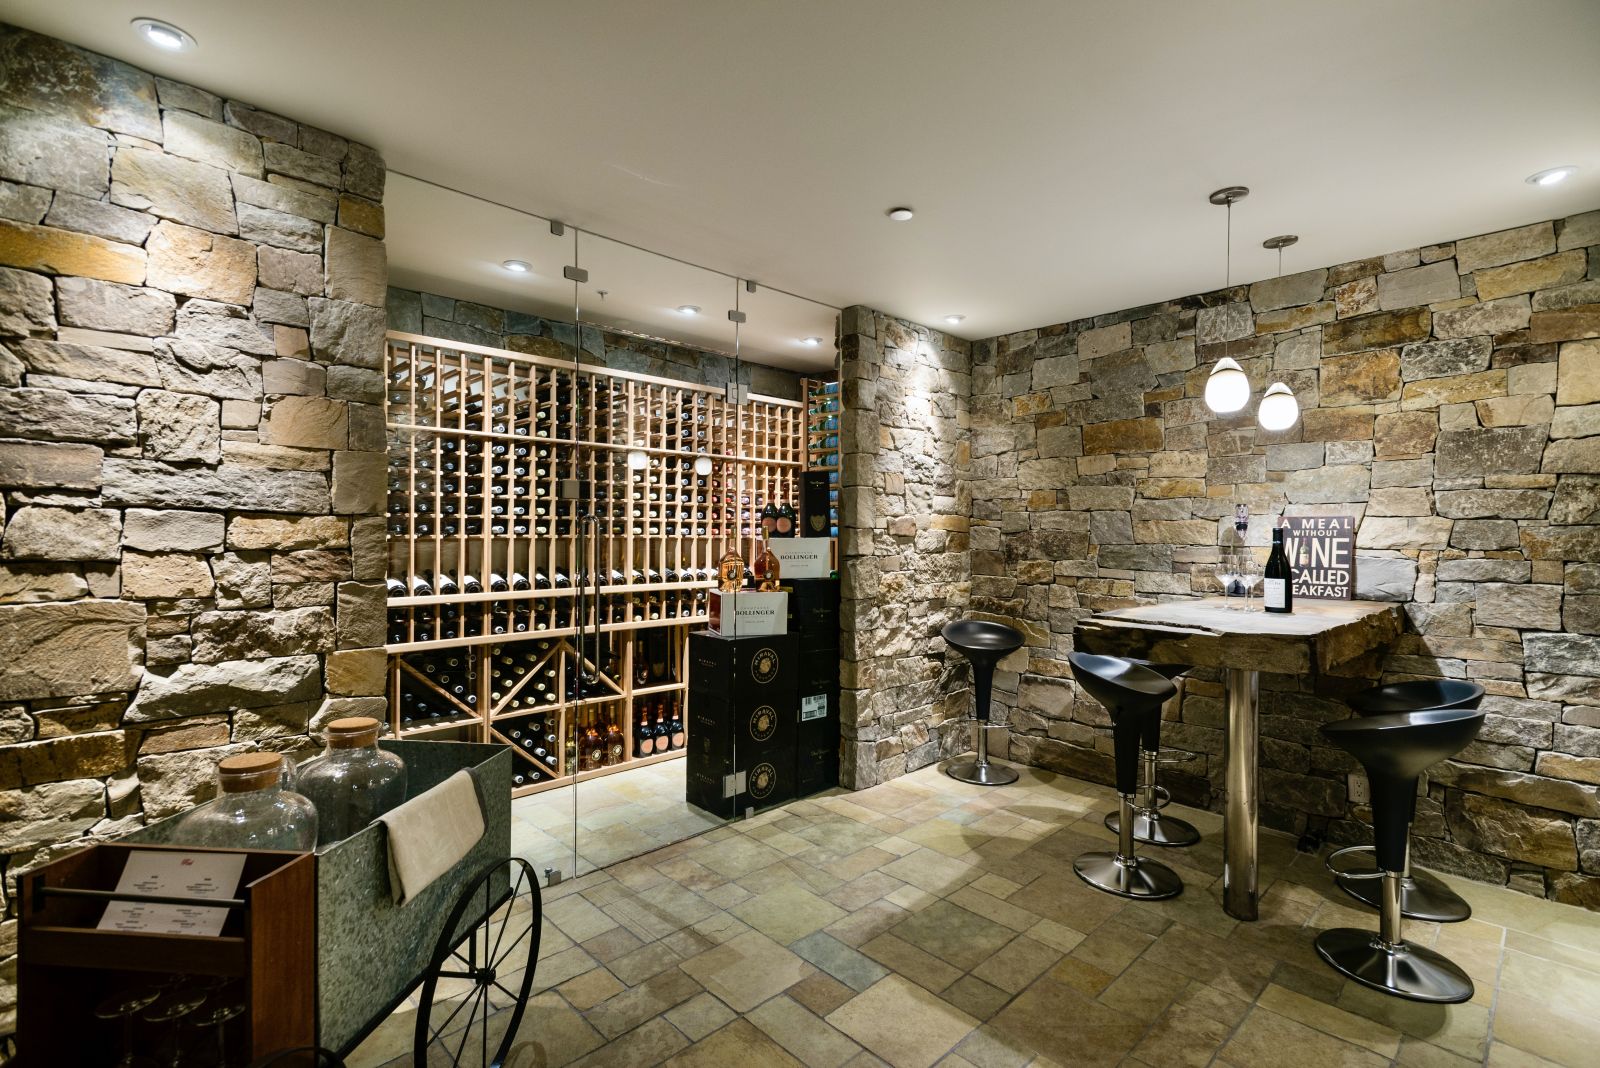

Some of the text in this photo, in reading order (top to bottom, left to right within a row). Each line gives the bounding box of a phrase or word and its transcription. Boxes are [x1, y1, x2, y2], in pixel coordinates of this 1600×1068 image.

[1280, 518, 1350, 528] A MEAL
[1291, 569, 1349, 585] CALLED
[1292, 585, 1348, 597] EAKFAST
